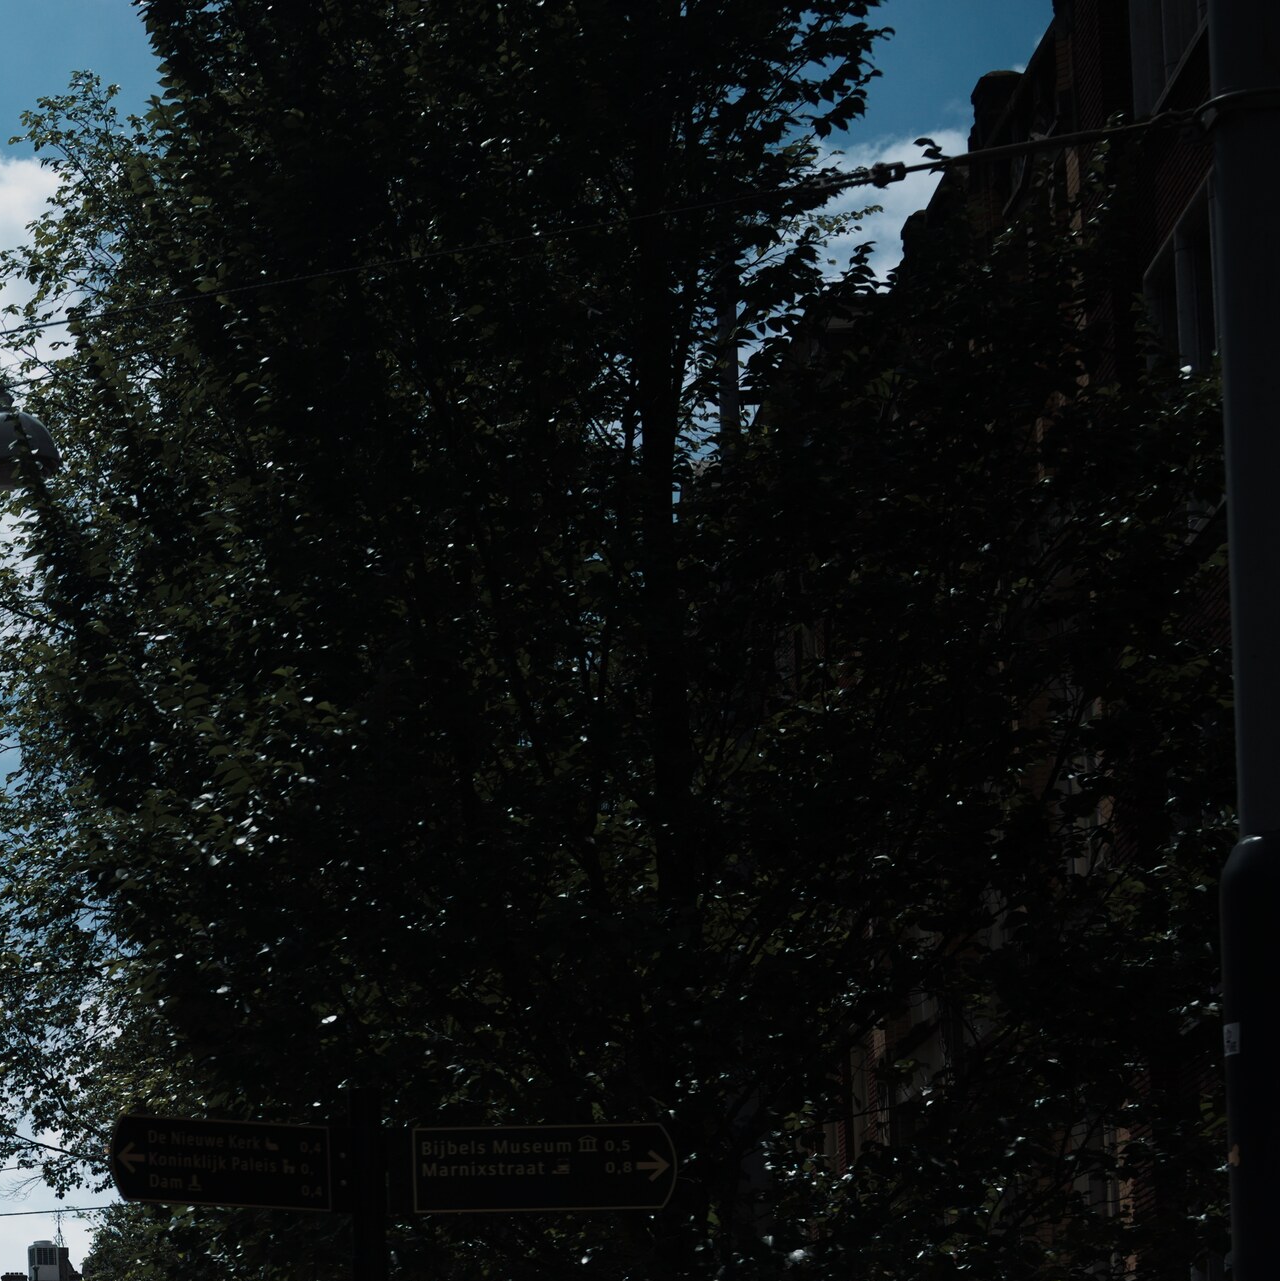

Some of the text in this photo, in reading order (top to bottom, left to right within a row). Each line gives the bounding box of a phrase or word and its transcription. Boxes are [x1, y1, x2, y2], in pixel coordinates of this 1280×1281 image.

[147, 1130, 168, 1145] De
[170, 1131, 225, 1148] Nieuwe
[228, 1134, 261, 1150] Kerk
[420, 1139, 487, 1159] Bijbels
[492, 1139, 572, 1155] Museum
[147, 1151, 228, 1173] Koninklijk
[231, 1156, 277, 1173] Paleis
[421, 1160, 545, 1177] Marnixstraat
[148, 1173, 183, 1189] Dam
